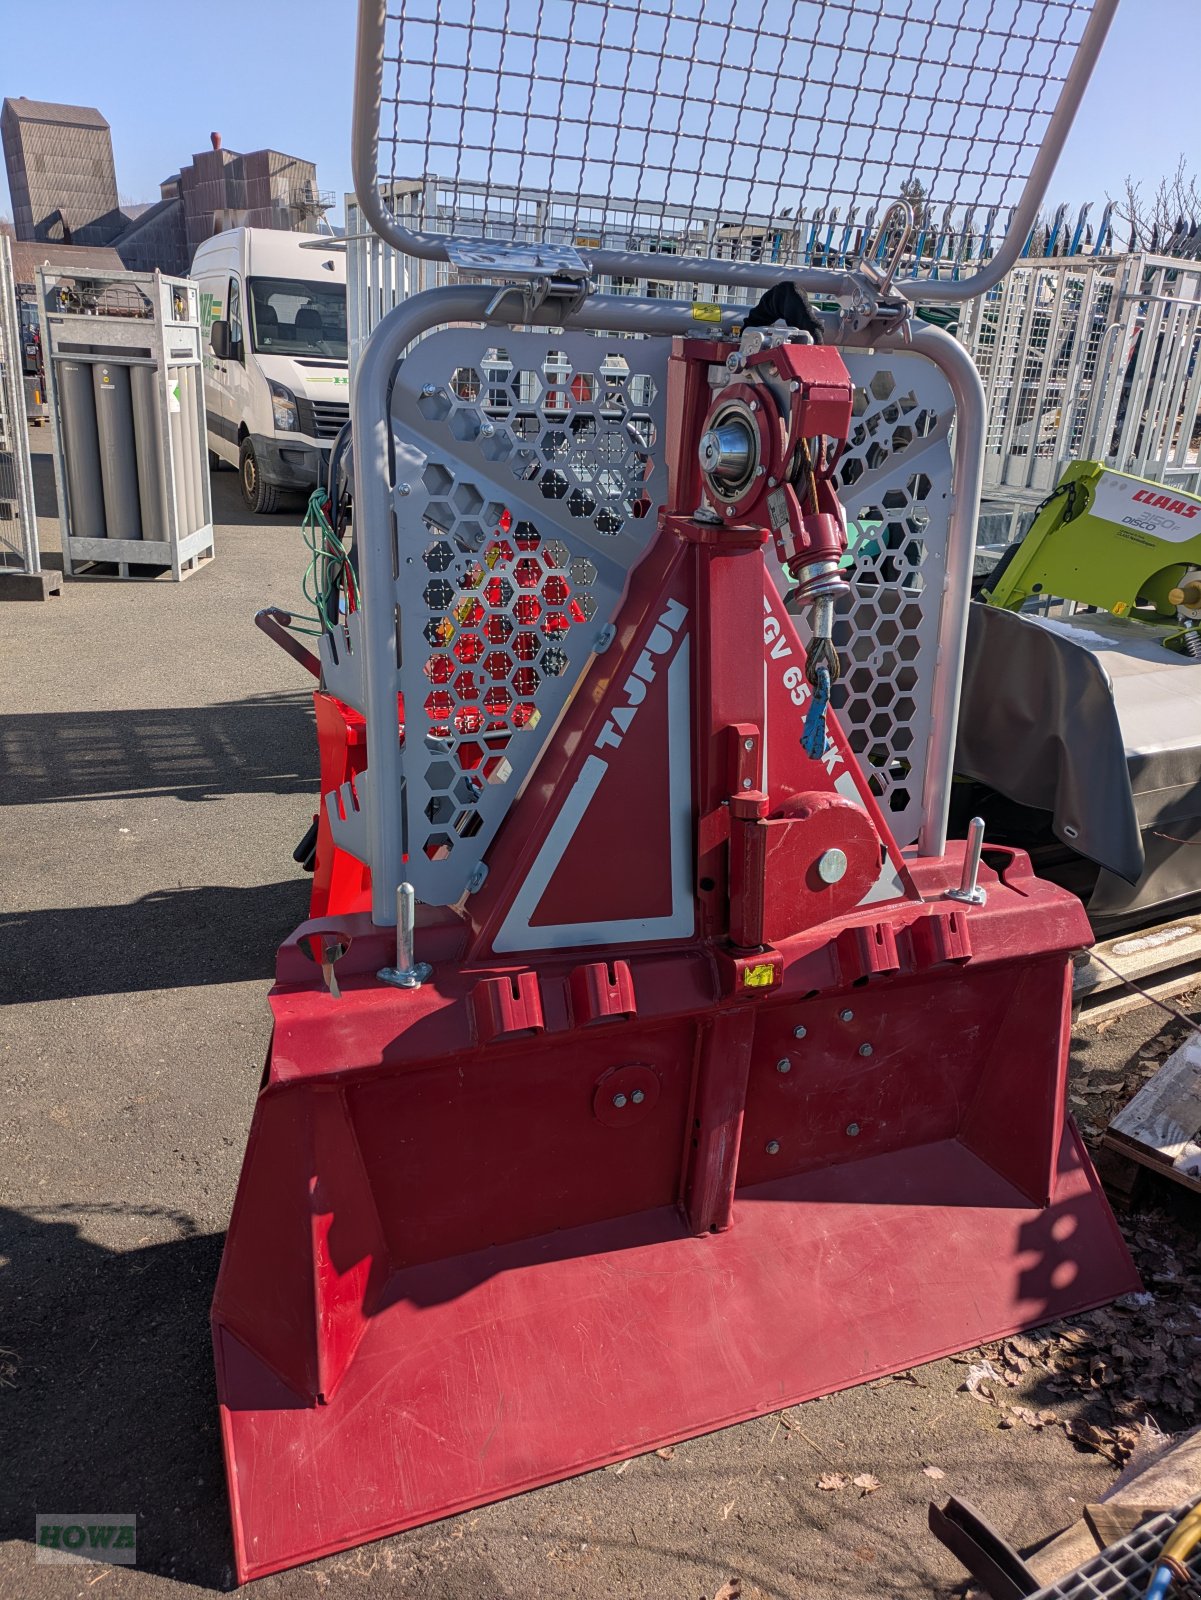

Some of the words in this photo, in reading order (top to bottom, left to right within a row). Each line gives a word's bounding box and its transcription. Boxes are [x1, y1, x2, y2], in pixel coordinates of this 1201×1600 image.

[1131, 489, 1201, 518] CLAAS
[1121, 516, 1156, 531] DISCO
[594, 598, 689, 749] TAJFUN
[783, 667, 811, 706] 65
